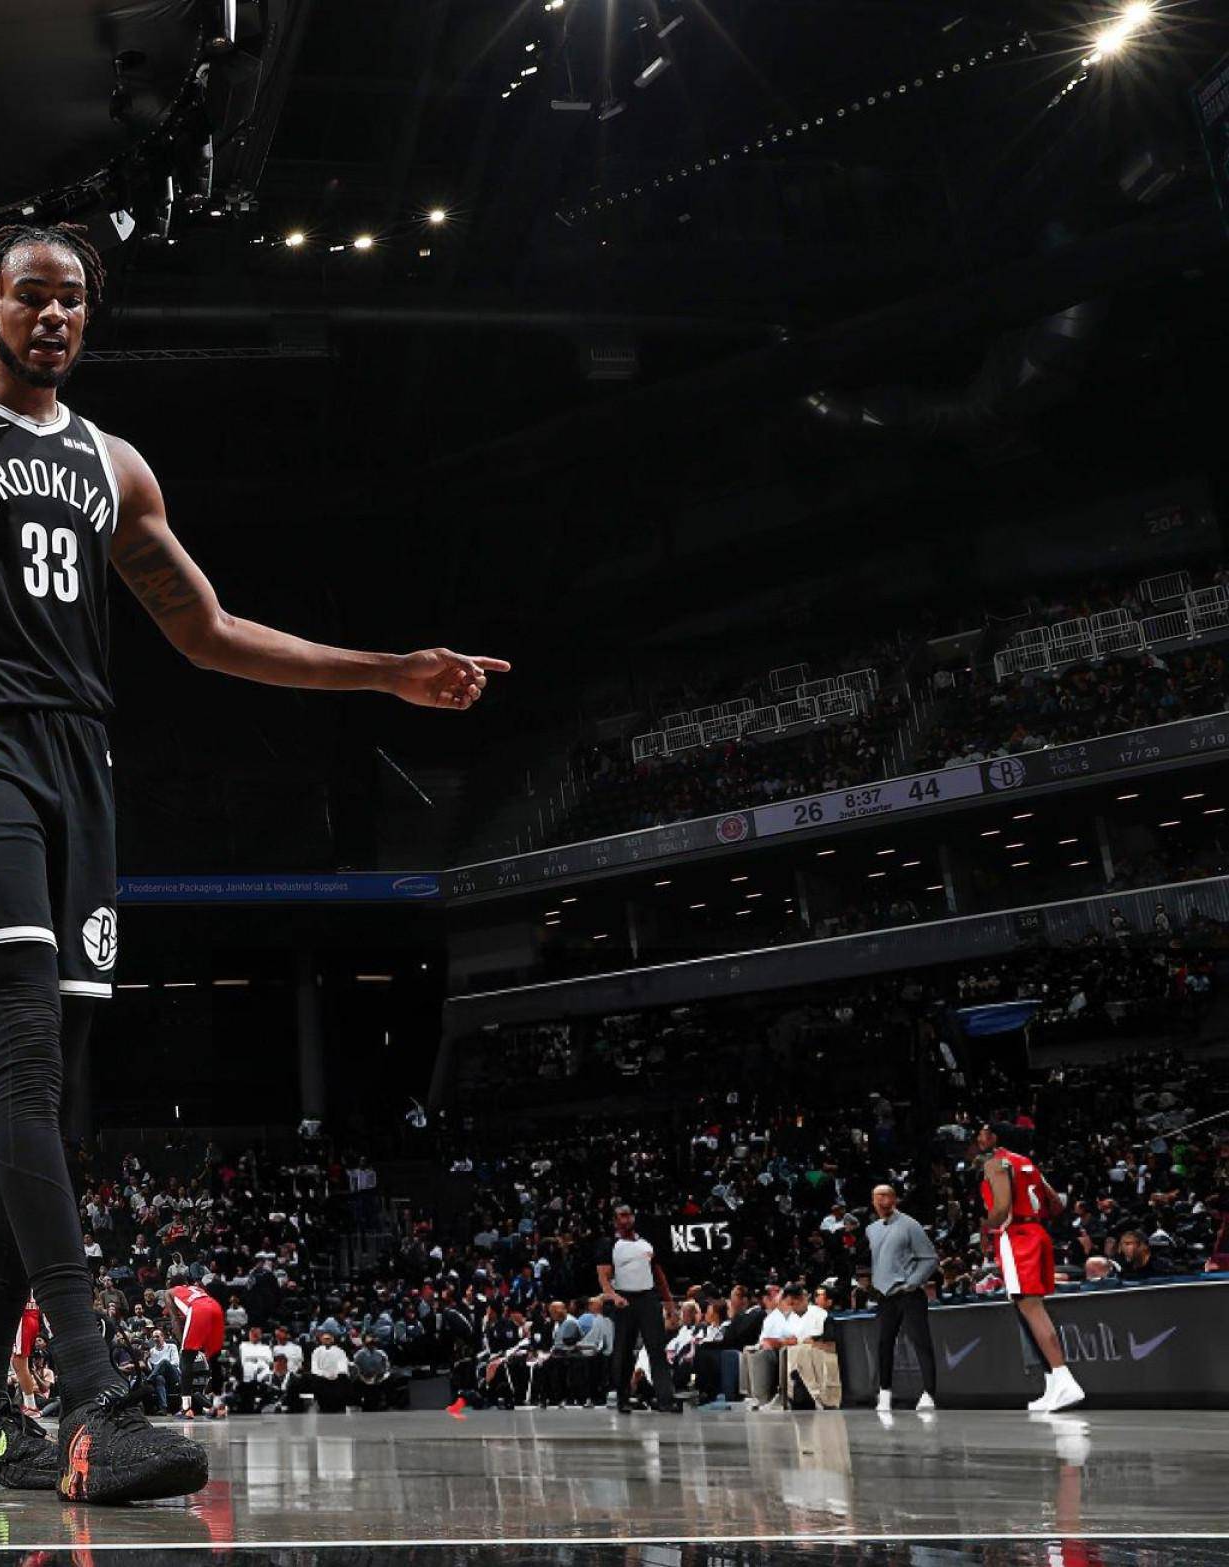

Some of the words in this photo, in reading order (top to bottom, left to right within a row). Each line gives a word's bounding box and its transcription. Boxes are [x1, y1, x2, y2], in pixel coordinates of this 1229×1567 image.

[21, 522, 79, 603] 33
[845, 788, 882, 808] 8:37
[908, 777, 940, 801] 44
[793, 801, 824, 825] 26
[839, 810, 856, 820] 2nd
[859, 802, 893, 817] Quarter
[128, 882, 178, 893] Foodservice
[225, 881, 263, 892] Janitorial
[274, 881, 313, 891] Industrial
[314, 881, 348, 892] Supplies
[671, 1220, 732, 1252] NETS
